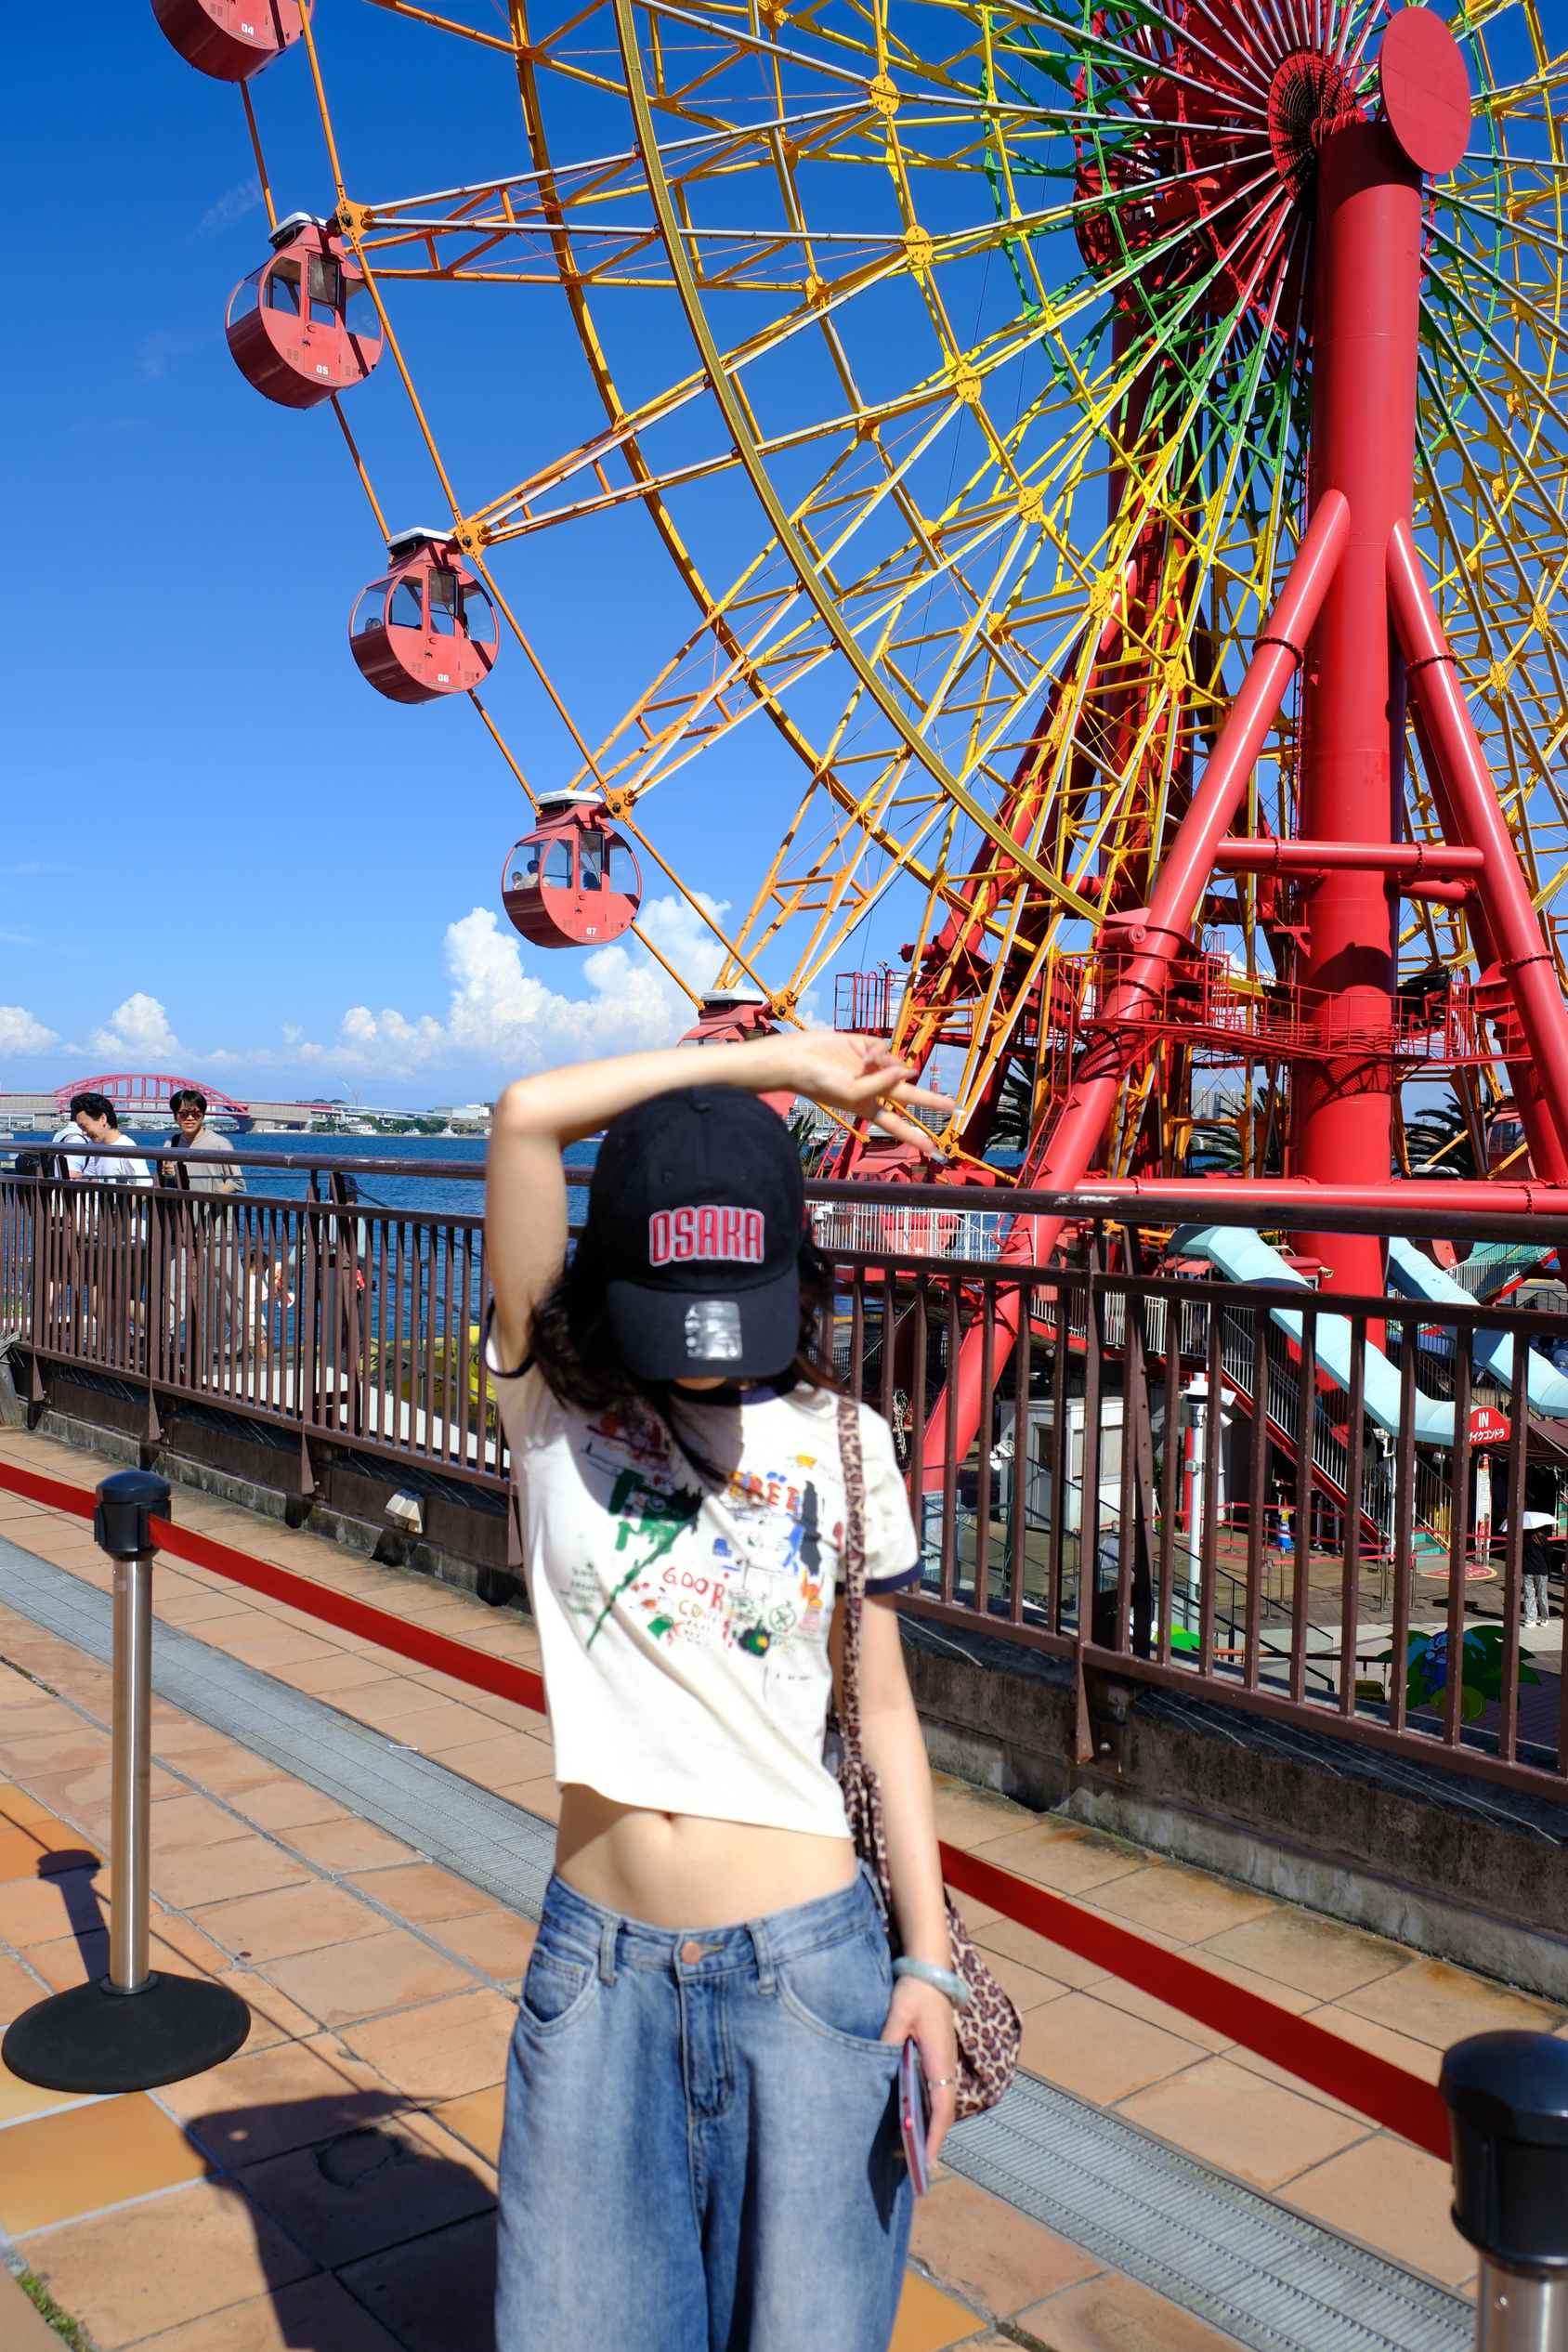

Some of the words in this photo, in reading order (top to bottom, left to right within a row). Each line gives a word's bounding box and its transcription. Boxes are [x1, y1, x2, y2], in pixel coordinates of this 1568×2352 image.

[242, 22, 255, 35] 04
[316, 364, 329, 375] 05
[438, 673, 449, 683] 06
[586, 926, 597, 935] 07
[648, 1205, 764, 1266] OSAKA
[1478, 1411, 1489, 1428] IN
